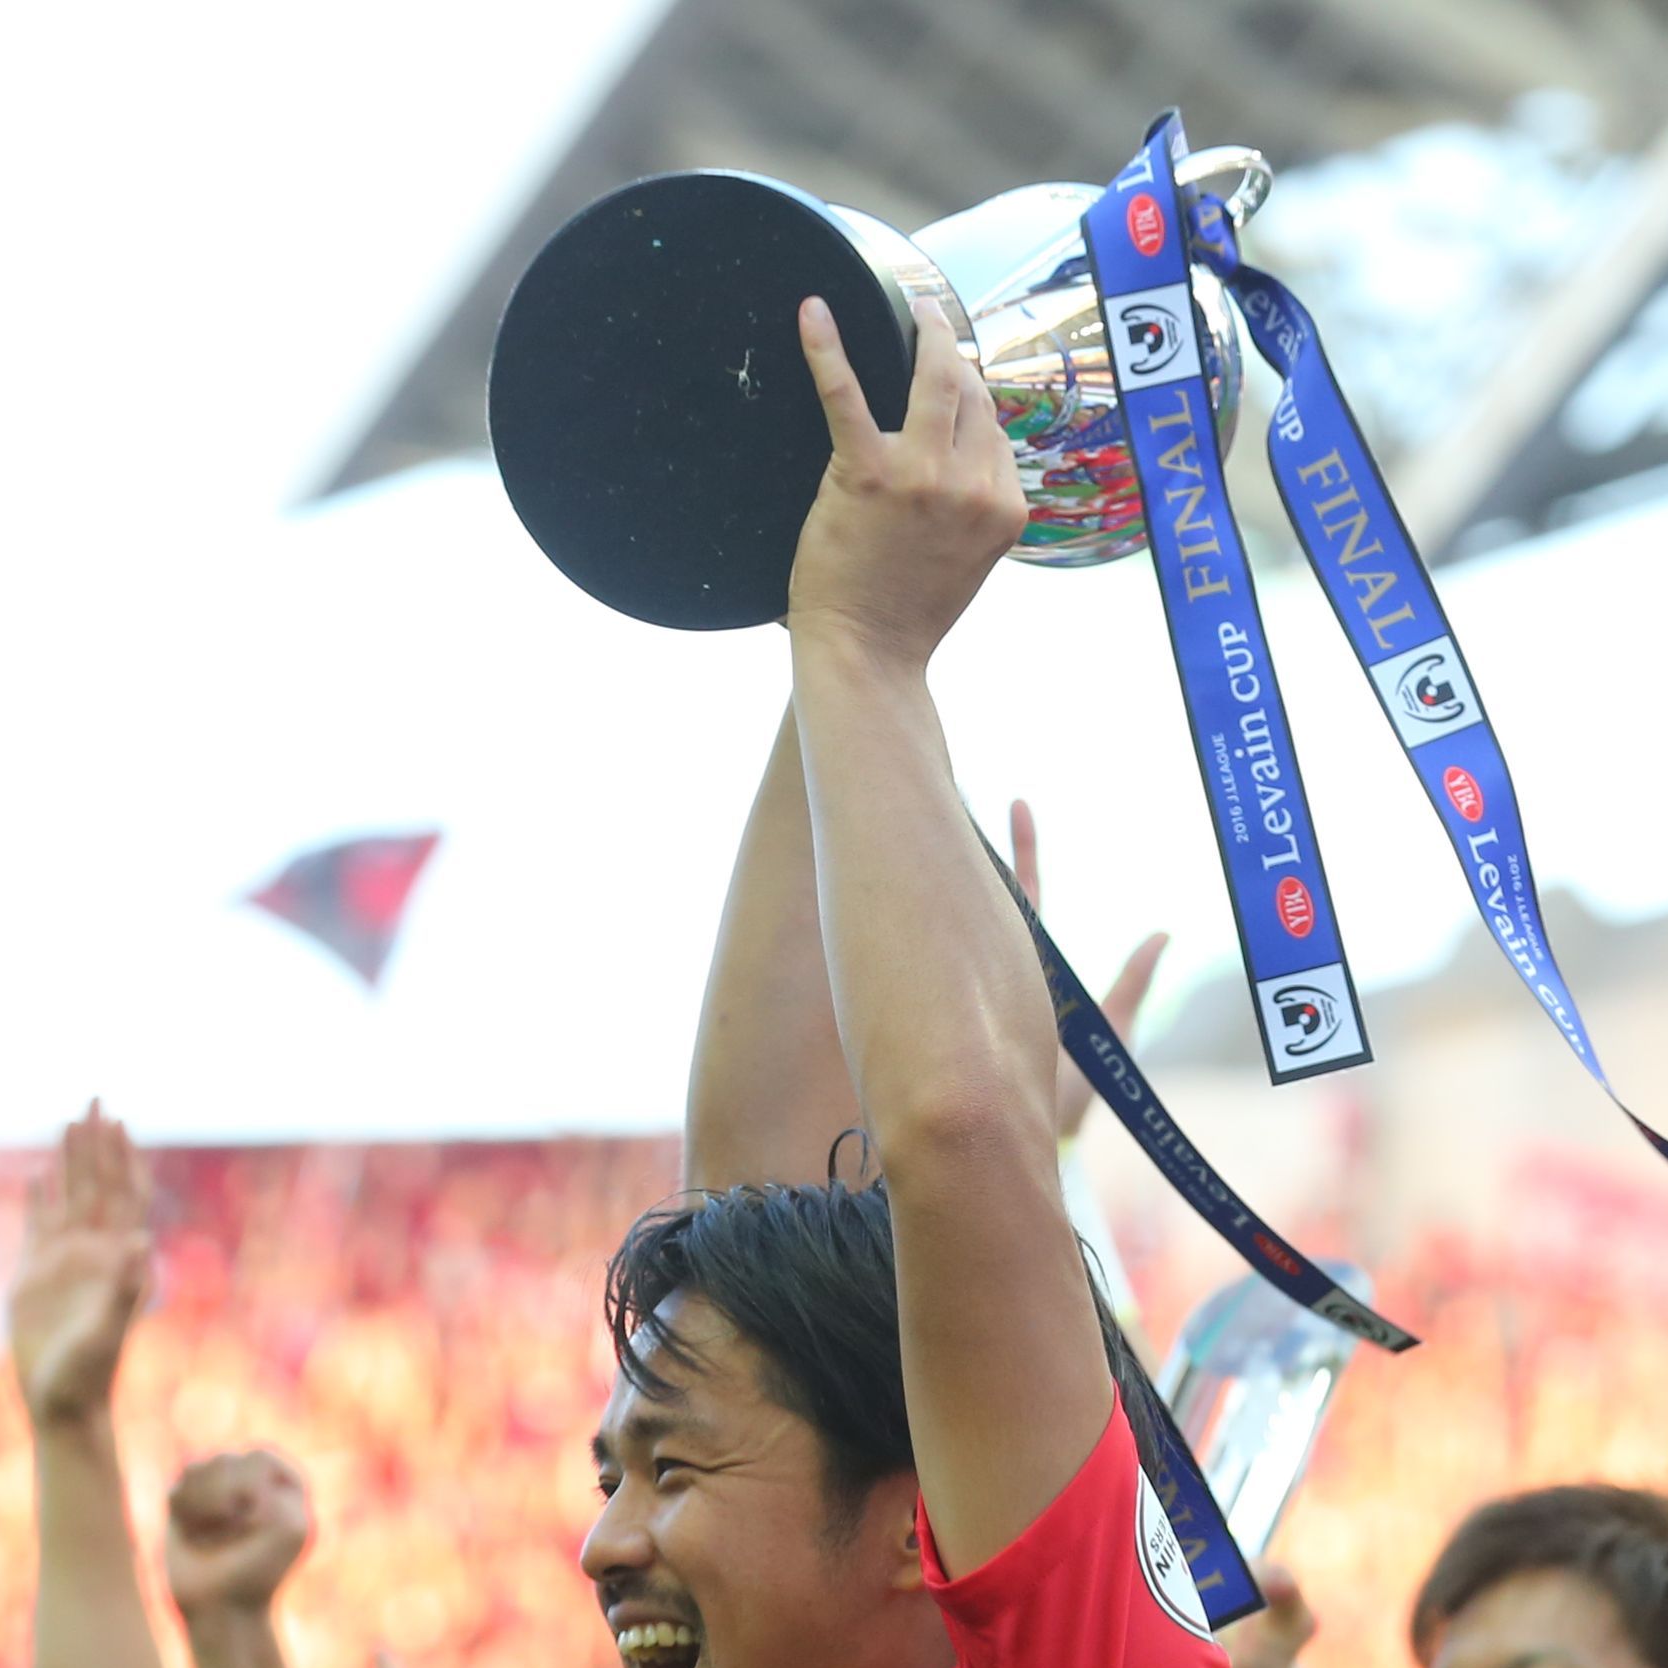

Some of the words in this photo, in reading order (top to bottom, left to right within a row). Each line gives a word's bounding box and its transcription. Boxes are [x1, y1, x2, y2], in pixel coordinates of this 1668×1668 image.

[1149, 390, 1232, 603] FINAL
[1297, 448, 1415, 650] FINAL
[1218, 621, 1261, 704] CUP
[1233, 804, 1249, 844] 2016
[1236, 708, 1301, 870] Levain
[1283, 888, 1309, 930] YBC
[1507, 854, 1522, 891] 2016
[1447, 773, 1478, 814] YBC
[1467, 827, 1537, 980] Levain
[1537, 982, 1586, 1057] CUP
[1089, 1032, 1142, 1103] CUP
[1143, 1104, 1250, 1230] Levain
[1155, 1530, 1178, 1579] HIN
